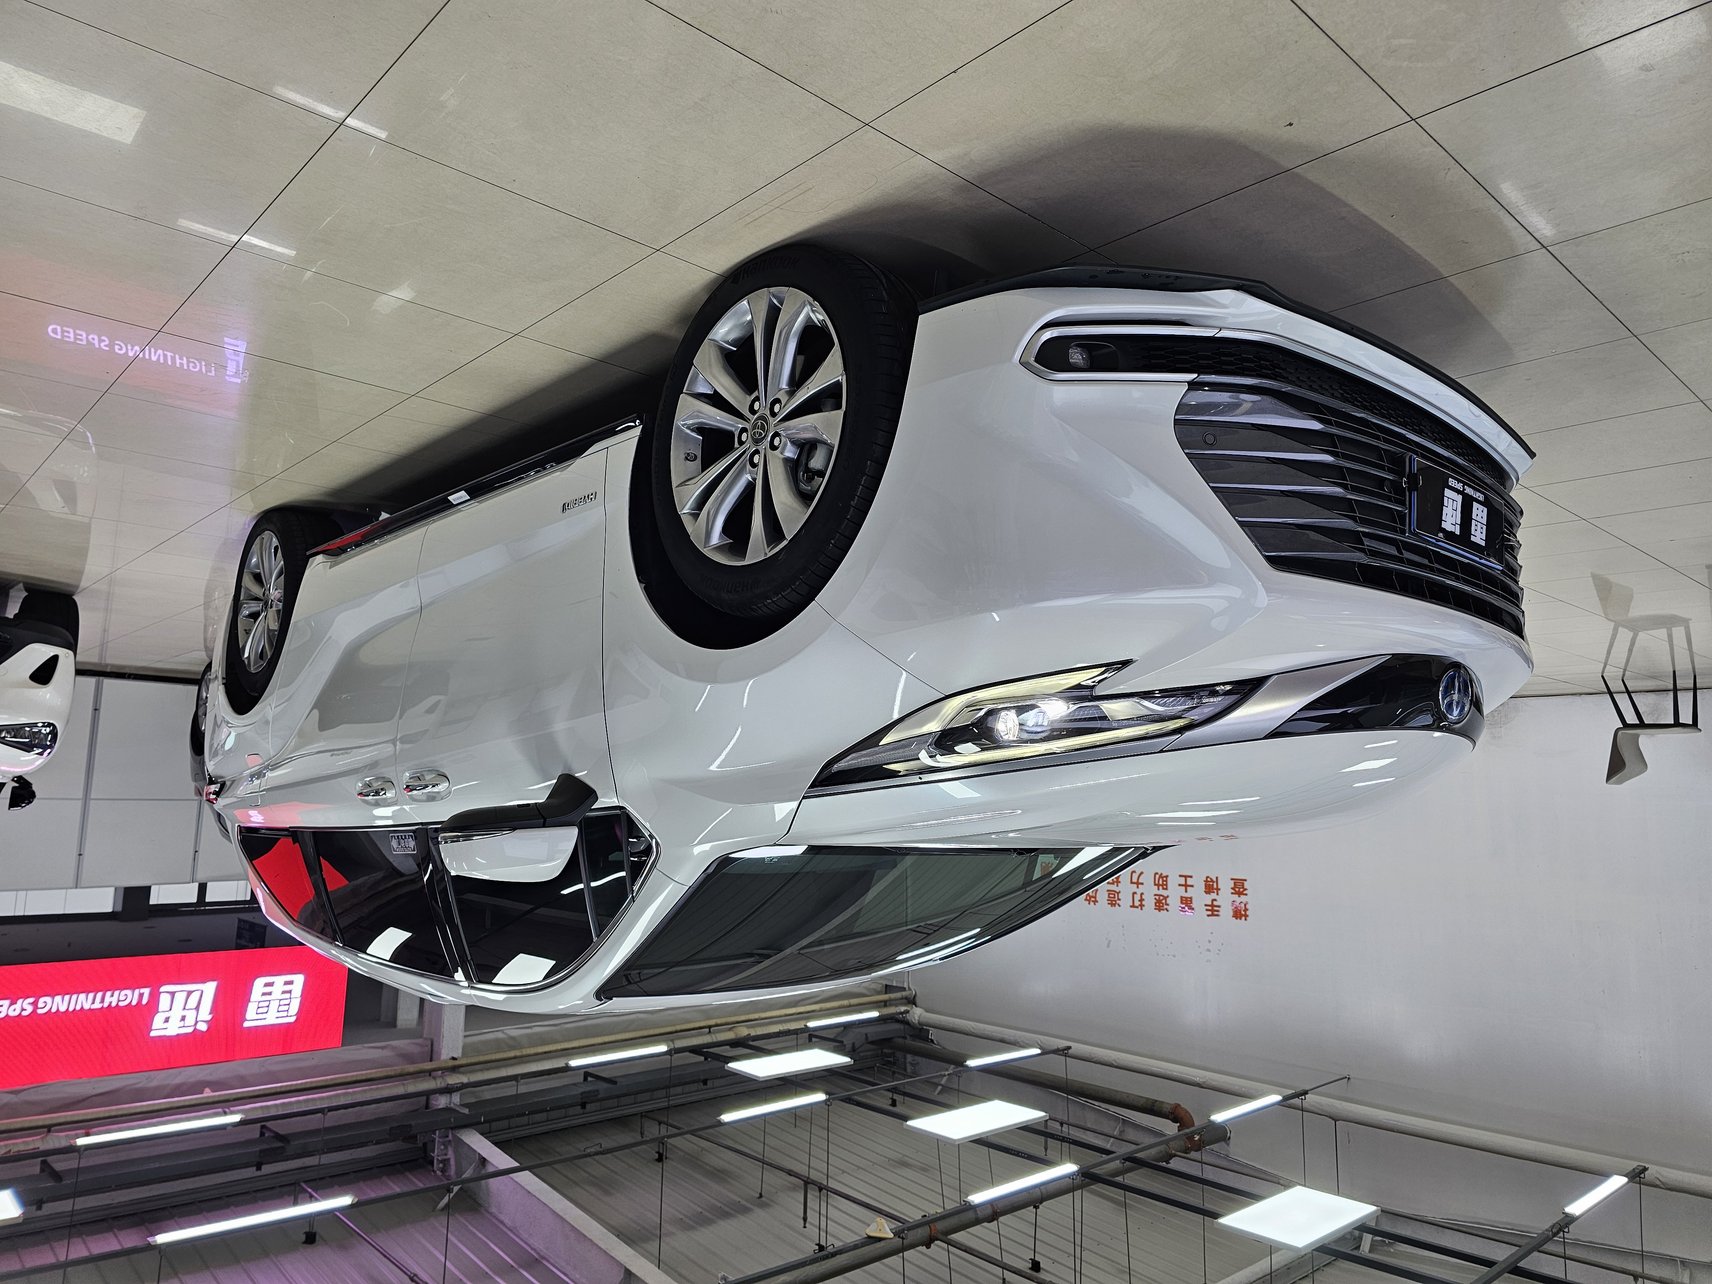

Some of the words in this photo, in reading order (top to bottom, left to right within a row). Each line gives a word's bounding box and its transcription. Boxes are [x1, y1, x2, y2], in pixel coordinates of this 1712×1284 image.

[1448, 478, 1464, 491] SPEED
[37, 987, 150, 1014] LIGHTNING
[149, 974, 305, 1037] 雷速
